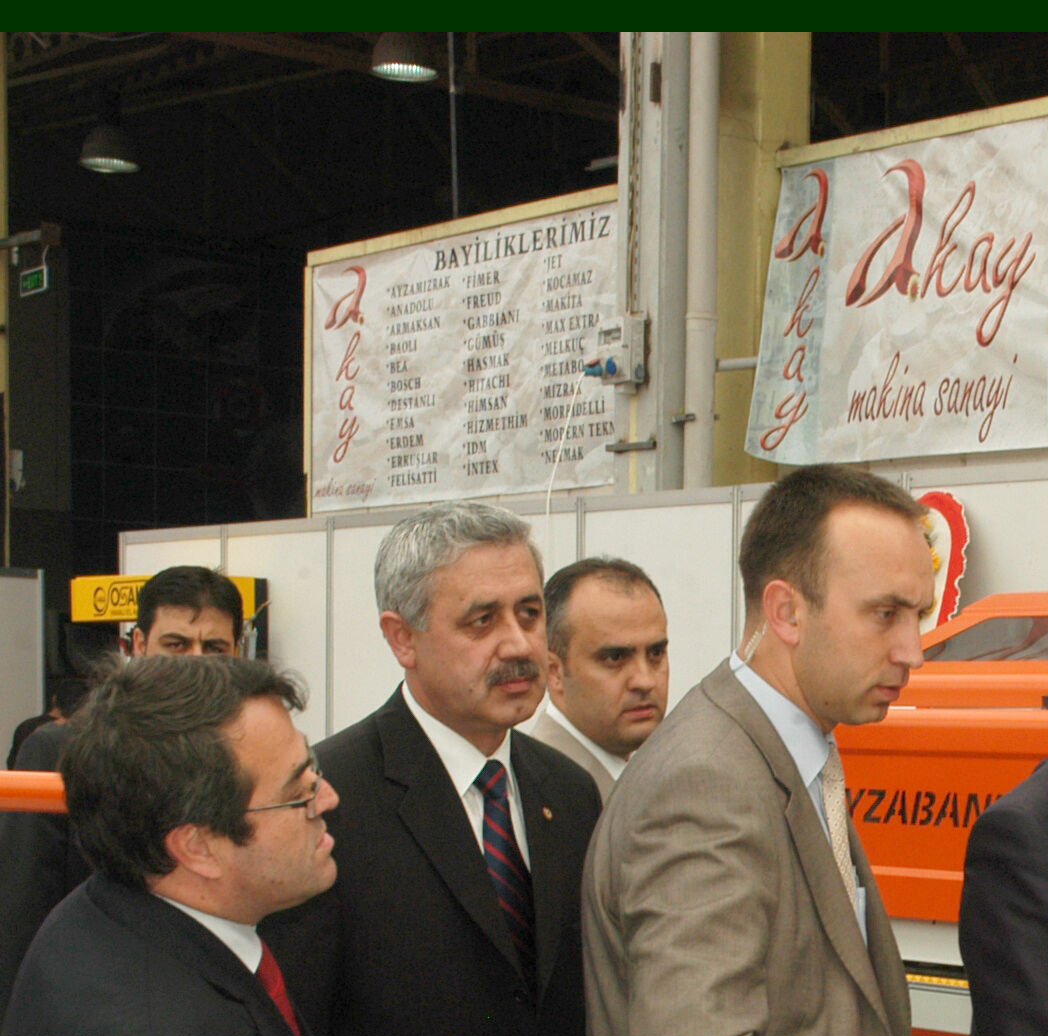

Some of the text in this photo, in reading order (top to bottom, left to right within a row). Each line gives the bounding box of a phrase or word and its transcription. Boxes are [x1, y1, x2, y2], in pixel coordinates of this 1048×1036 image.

[434, 212, 611, 271] BAYİLİKLERİMİZ
[391, 298, 434, 318] ANADOLU
[467, 292, 502, 310] FREUD
[546, 318, 566, 334] MAX
[467, 353, 509, 373] HASMAK
[390, 377, 421, 392] BOSCH
[468, 374, 510, 392] HITACHI
[847, 351, 1018, 443] makina sanayi
[390, 434, 424, 450] ERDEM
[845, 788, 1002, 827] YZABAN
